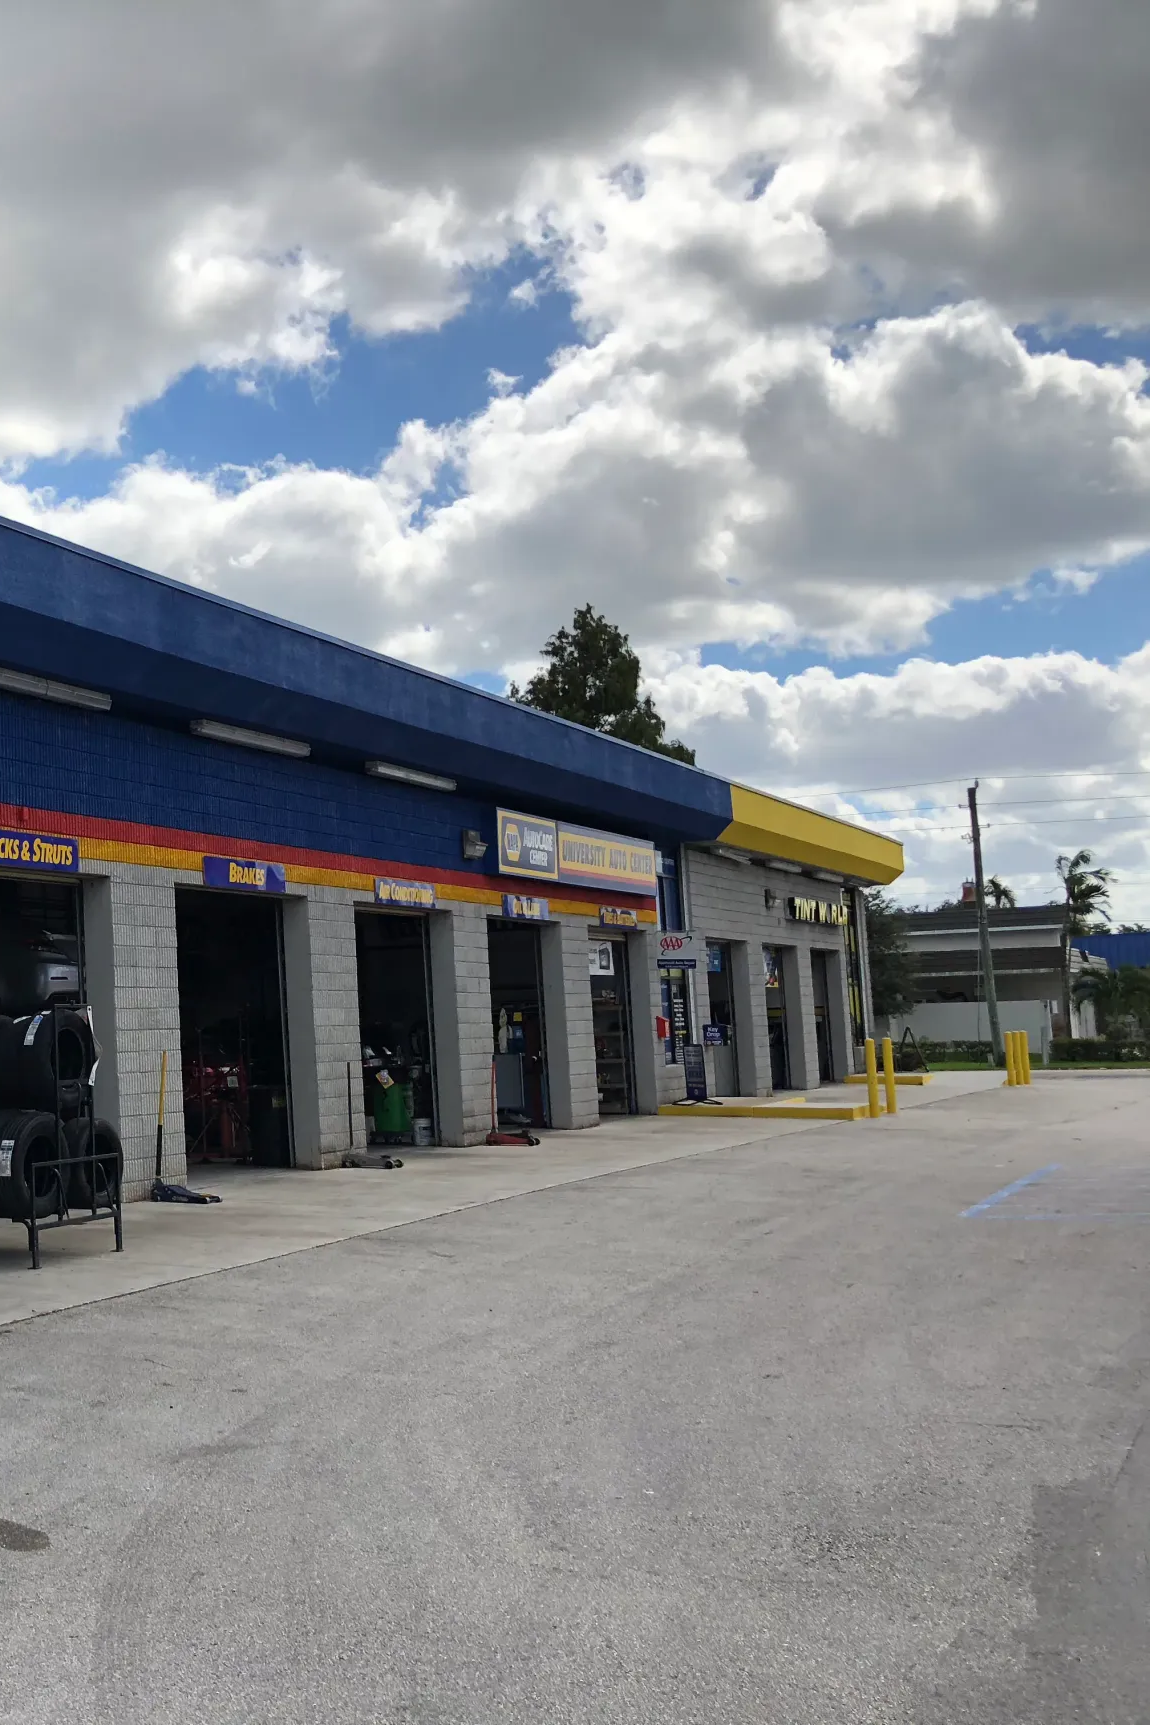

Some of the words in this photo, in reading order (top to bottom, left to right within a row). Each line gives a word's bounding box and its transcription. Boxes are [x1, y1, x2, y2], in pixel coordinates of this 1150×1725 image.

[21, 840, 31, 861] &
[32, 838, 72, 865] STRUTS
[529, 849, 548, 866] CENTER
[562, 840, 606, 868] UNIVERSITY
[609, 849, 627, 871] AUTO
[630, 852, 653, 875] CENTER
[229, 862, 265, 886] BRAKES
[379, 881, 390, 899] AIR
[391, 883, 434, 904] CONDITIONING
[794, 897, 816, 922] TINT
[661, 937, 683, 950] AAA
